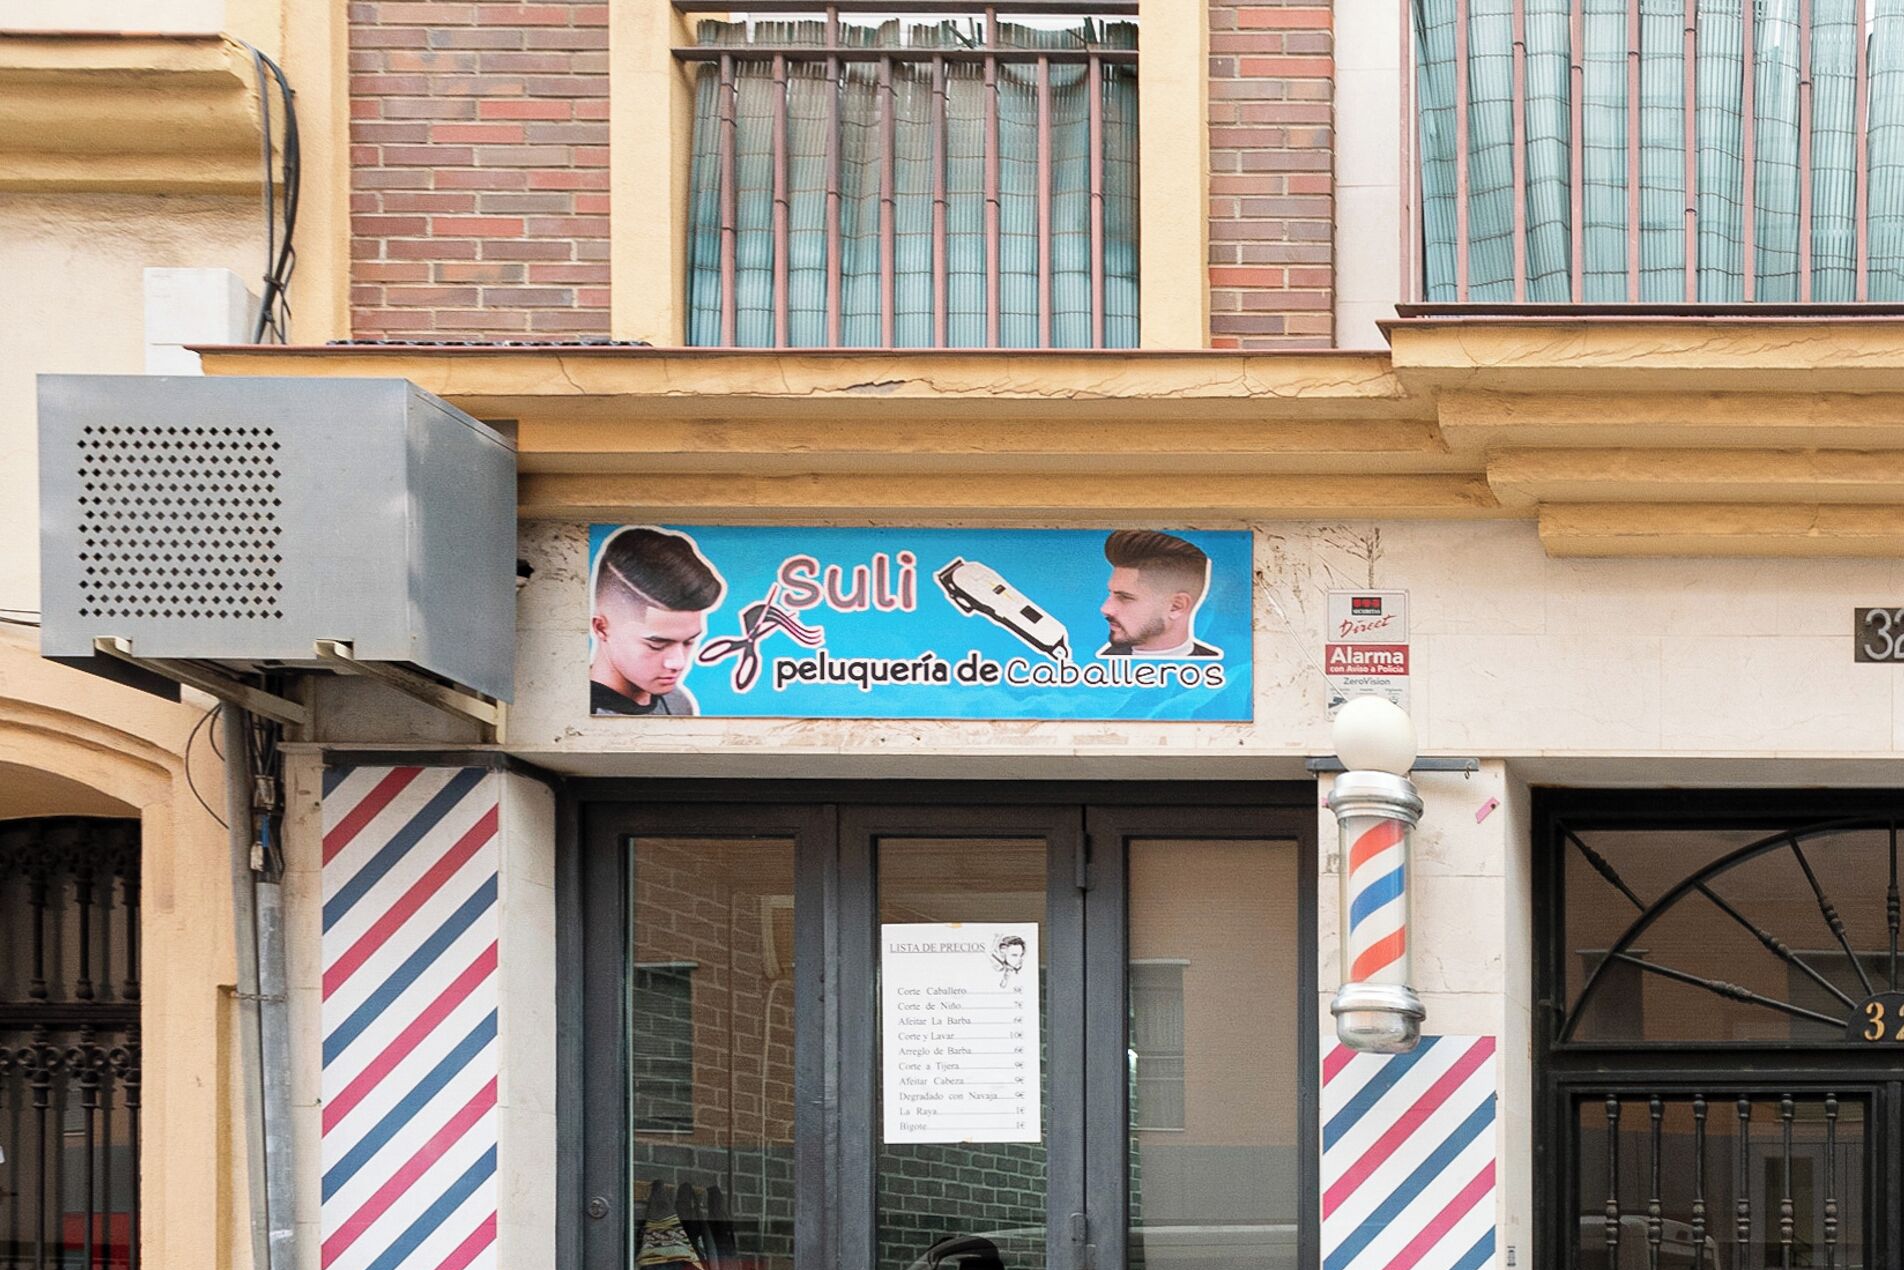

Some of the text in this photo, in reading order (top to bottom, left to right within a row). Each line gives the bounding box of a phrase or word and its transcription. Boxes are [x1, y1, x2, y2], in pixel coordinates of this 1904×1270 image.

[779, 551, 917, 610] Suli
[1339, 614, 1397, 638] Direct
[1330, 646, 1404, 664] Alarma
[776, 652, 1224, 689] peluquería de Caballeros
[1330, 665, 1344, 673] con
[1347, 665, 1369, 673] Aviso
[1343, 677, 1391, 685] ZeroVision
[889, 943, 985, 953] LISTA DE PRECIOS
[897, 986, 967, 995] Corte Caballero
[897, 1002, 920, 1010] Corte
[925, 1002, 936, 1010] de
[931, 1016, 942, 1025] La
[947, 1016, 971, 1025] Barba
[933, 1047, 944, 1055] de
[947, 1046, 972, 1055] Barba
[898, 1062, 922, 1070] Corte
[933, 1076, 964, 1085] Cabeza
[899, 1091, 944, 1101] Degradado
[899, 1107, 910, 1116] La
[916, 1107, 938, 1118] Raya
[899, 1121, 927, 1132] Bigote
